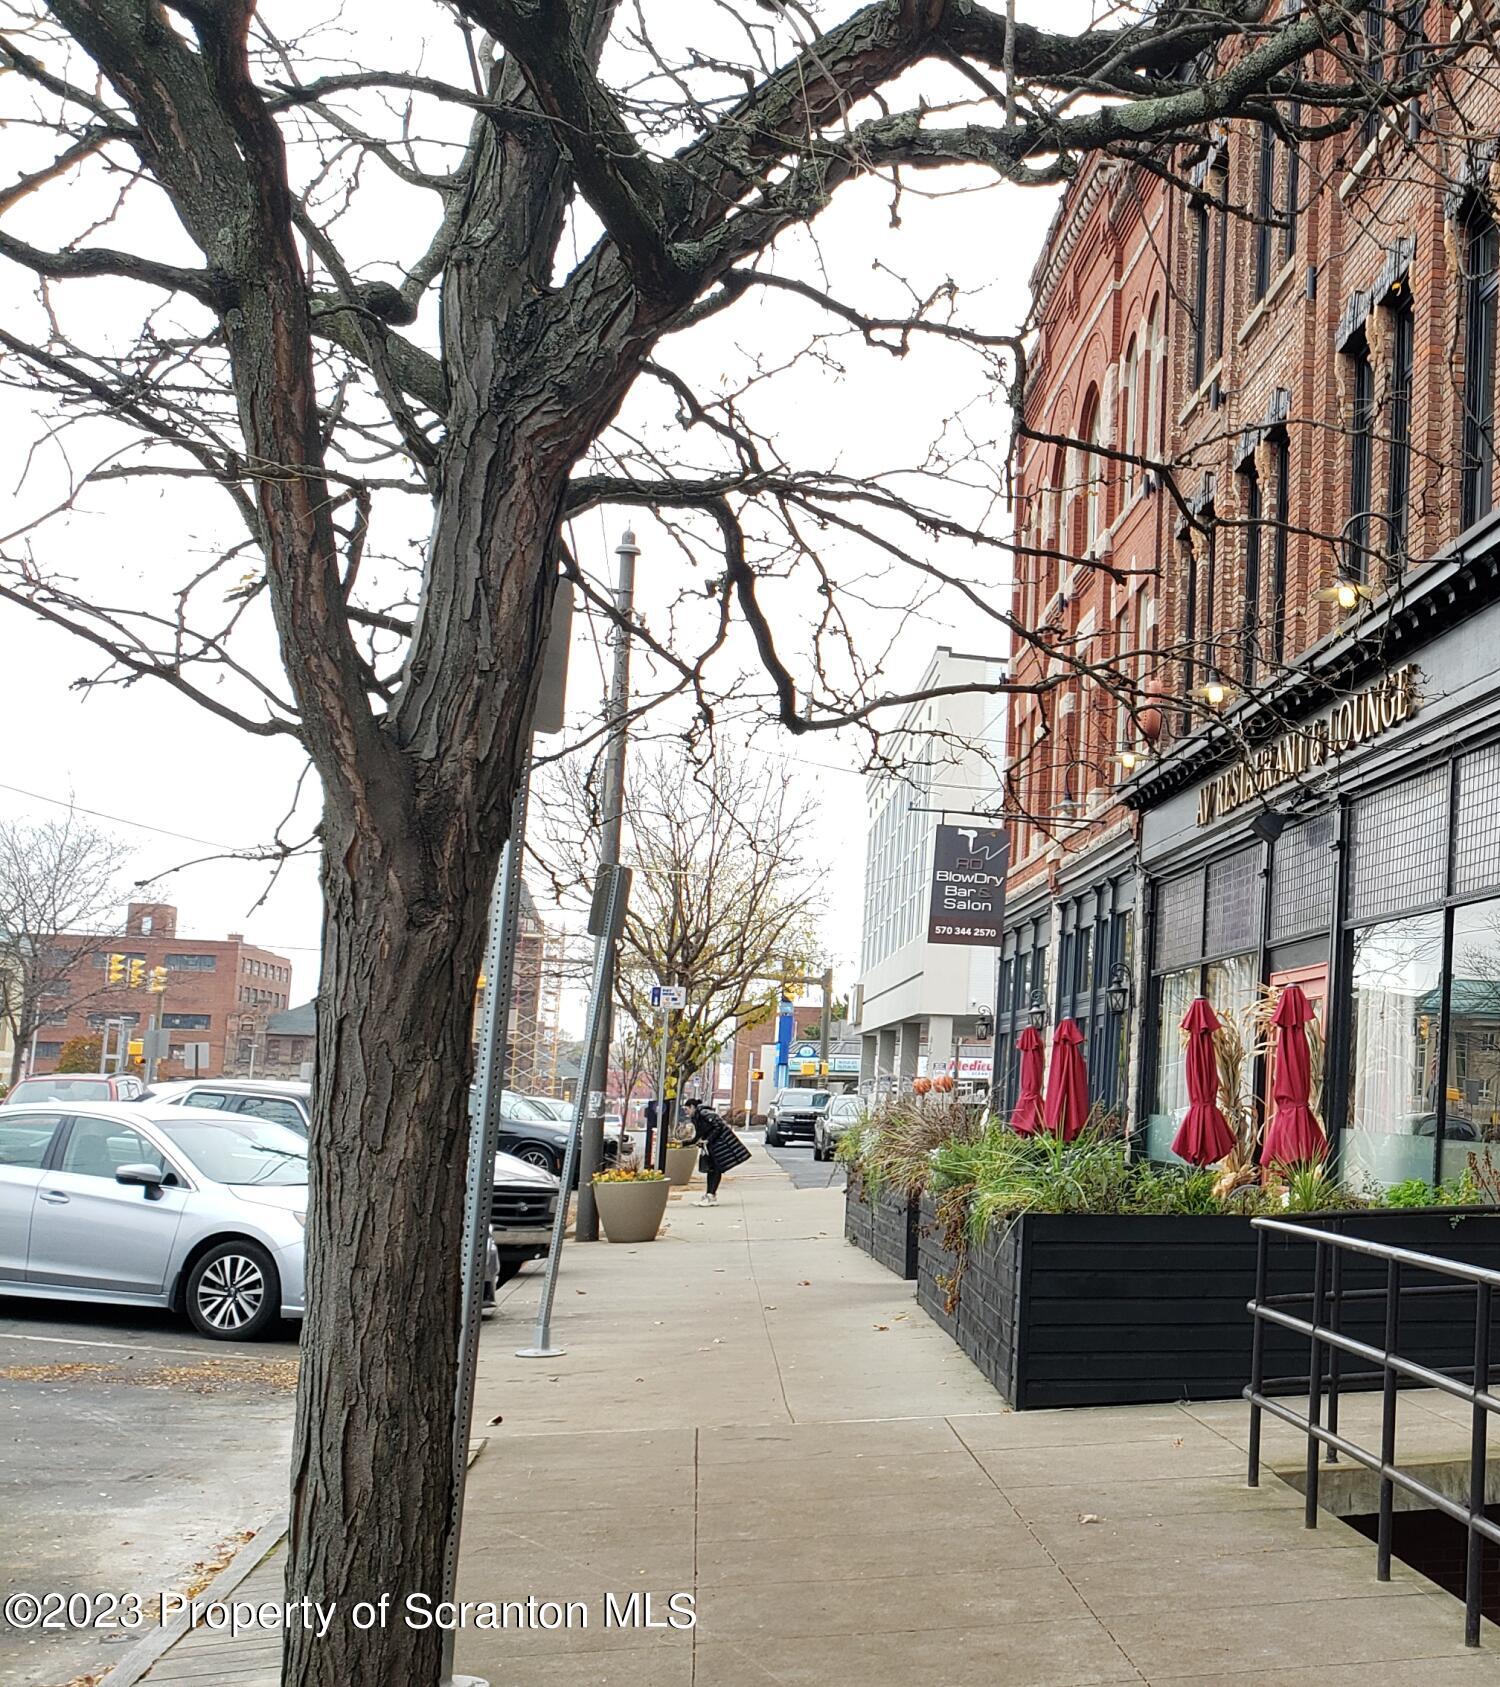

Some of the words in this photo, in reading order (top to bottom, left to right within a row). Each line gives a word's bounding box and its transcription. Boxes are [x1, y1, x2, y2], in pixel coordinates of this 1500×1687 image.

[1216, 726, 1309, 817] RESTAURANT
[1328, 664, 1410, 758] LOUNGE
[936, 870, 1005, 887] BlowDry
[945, 885, 977, 897] Bar
[943, 898, 992, 912] Salon
[935, 925, 953, 935] 570
[954, 927, 972, 936] 344
[973, 928, 997, 937] 2570
